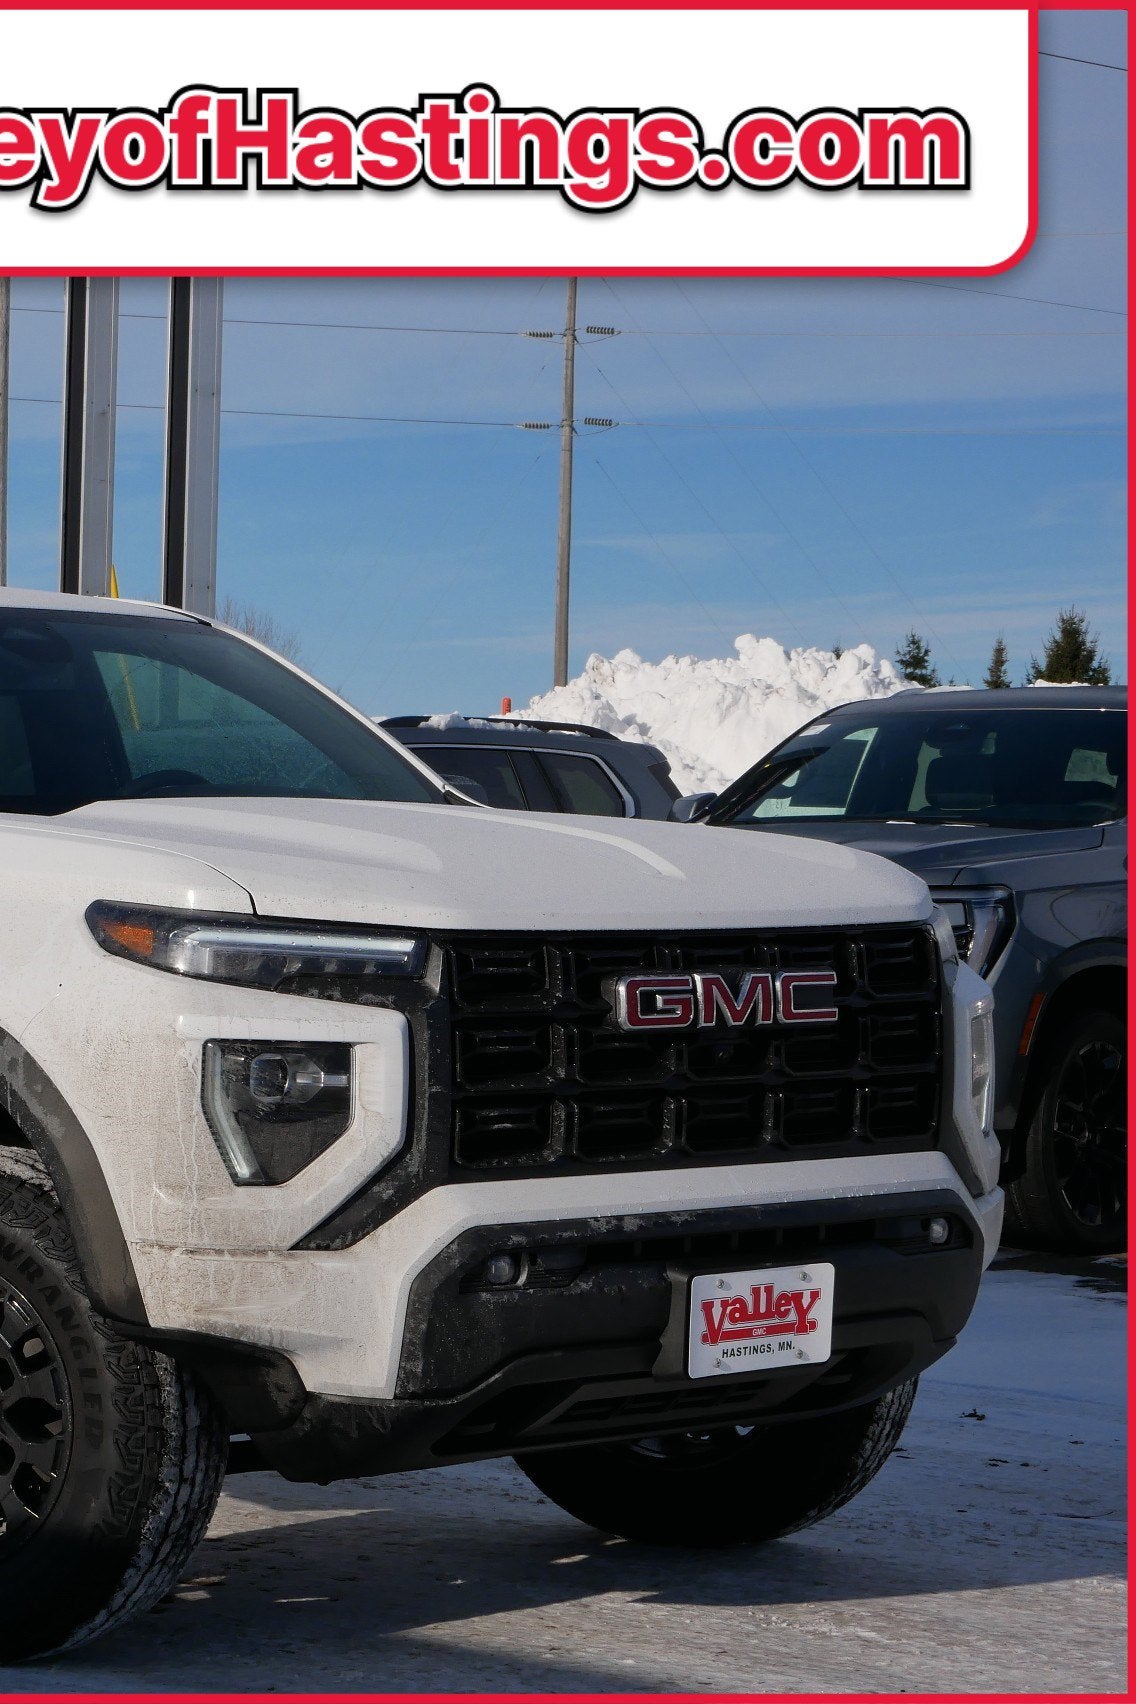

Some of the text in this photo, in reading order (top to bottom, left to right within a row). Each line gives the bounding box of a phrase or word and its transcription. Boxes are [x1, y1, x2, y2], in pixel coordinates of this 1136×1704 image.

[616, 971, 839, 1030] GMC
[752, 1328, 767, 1337] GMC
[721, 1341, 796, 1359] HASTINGS, MN.
